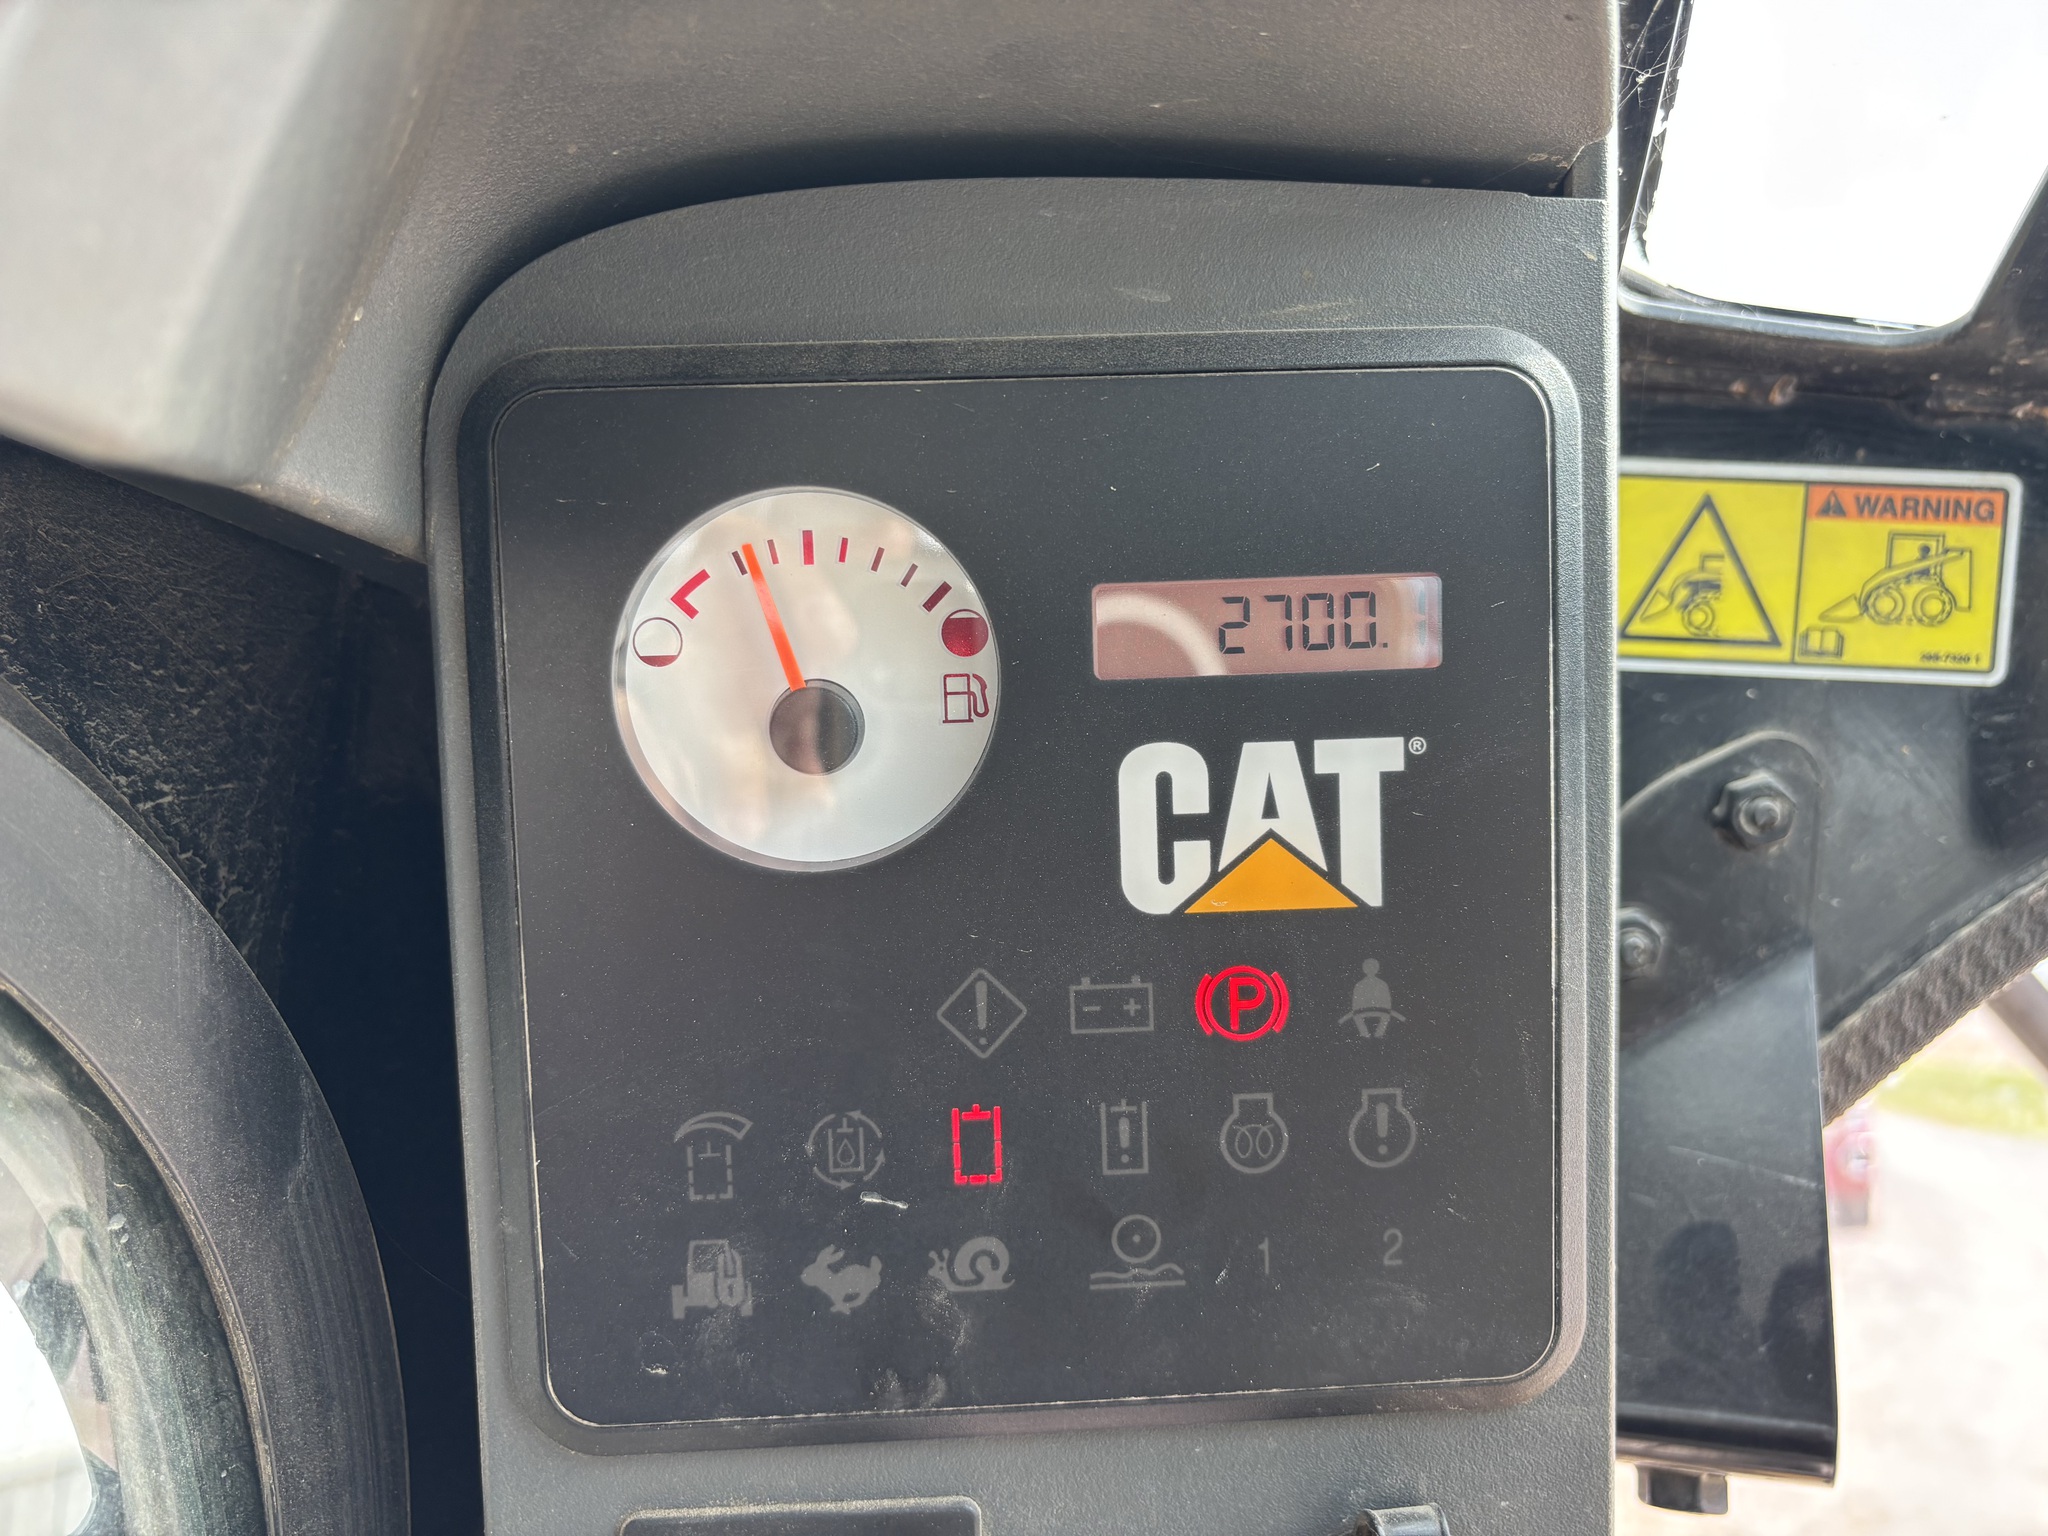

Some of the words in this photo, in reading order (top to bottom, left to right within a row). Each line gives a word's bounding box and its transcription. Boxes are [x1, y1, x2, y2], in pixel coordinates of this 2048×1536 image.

[1855, 494, 1995, 521] WARNING
[1228, 977, 1266, 1031] P
[1258, 1237, 1270, 1275] 1
[1383, 1228, 1403, 1266] 2
